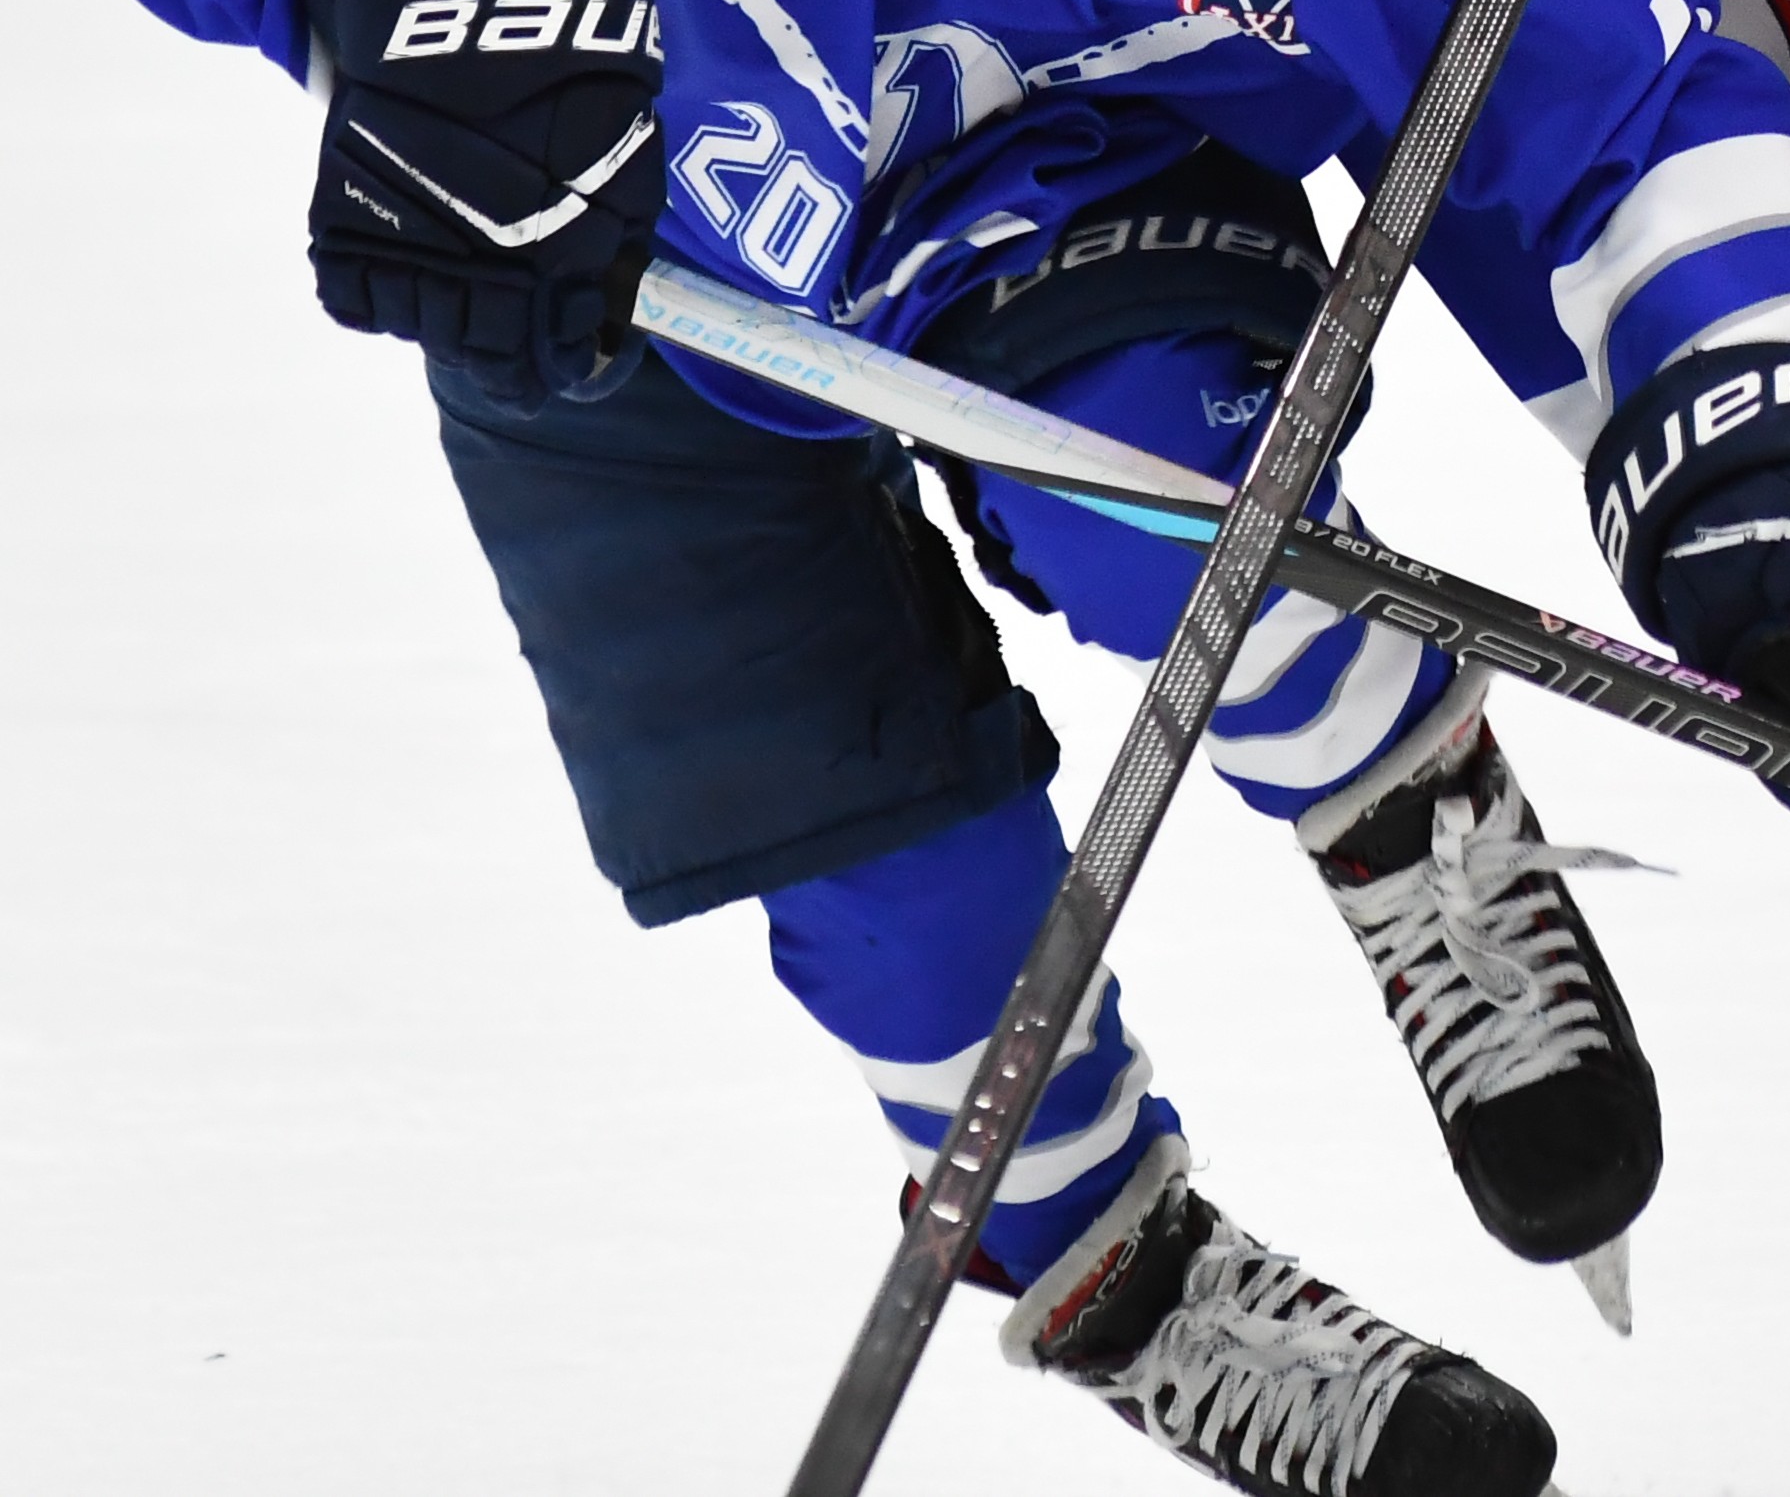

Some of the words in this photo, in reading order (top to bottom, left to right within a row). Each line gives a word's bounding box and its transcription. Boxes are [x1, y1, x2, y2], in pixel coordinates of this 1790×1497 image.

[668, 100, 854, 299] 20
[668, 313, 836, 391] BAUER
[1374, 549, 1444, 587] FLEX
[1565, 627, 1743, 705] BAUER
